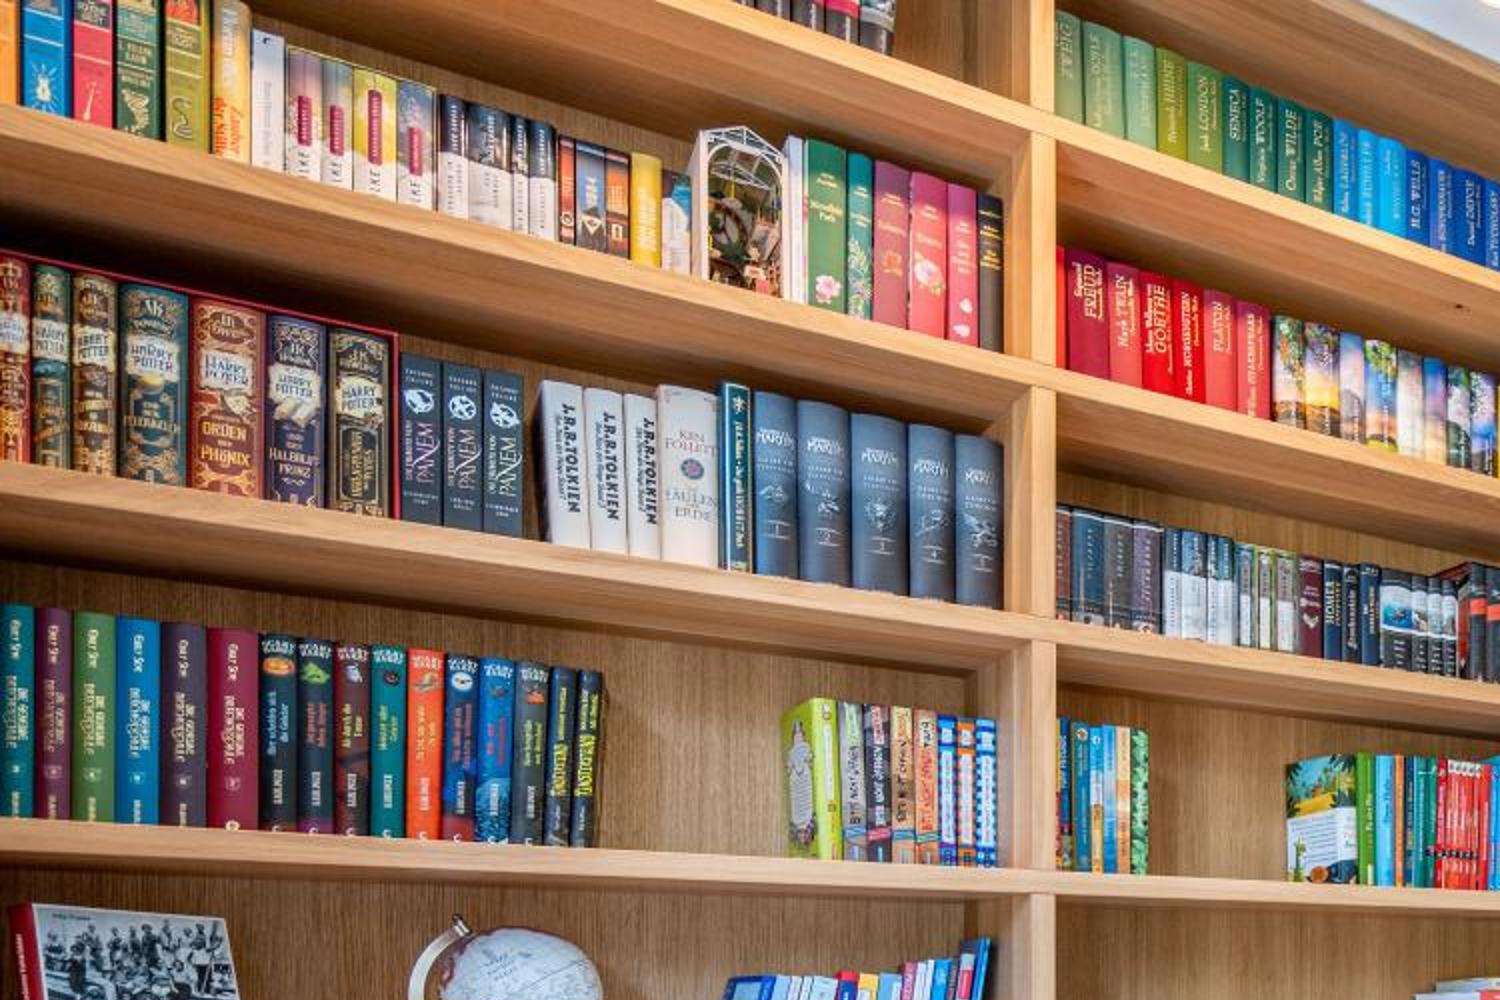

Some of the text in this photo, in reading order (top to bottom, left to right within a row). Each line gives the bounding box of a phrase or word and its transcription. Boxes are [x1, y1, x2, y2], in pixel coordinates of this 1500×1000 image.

[1198, 75, 1209, 131] LONDON
[1229, 89, 1242, 142] SENECA
[1255, 97, 1265, 145] WOOLF
[1284, 108, 1297, 157] WILDE
[1411, 159, 1421, 200] WELLS
[1084, 264, 1097, 319] FREUD
[1153, 285, 1166, 352] GOETHE
[1211, 301, 1224, 353] PLATON
[131, 344, 172, 360] HARRY
[132, 355, 173, 371] POTTER
[205, 356, 248, 375] HARRY
[205, 370, 249, 385] POTTER
[275, 383, 313, 399] POTTER
[342, 386, 376, 398] HARRY
[341, 397, 376, 409] POTTER
[203, 421, 247, 441] ORDEN
[664, 438, 717, 457] FOLLETT
[678, 429, 705, 442] KEN
[415, 423, 440, 483] PANEM
[453, 428, 482, 490] PANEM
[495, 436, 522, 497] PANEM
[674, 506, 714, 522] ERDE
[1324, 581, 1335, 625] HOMER
